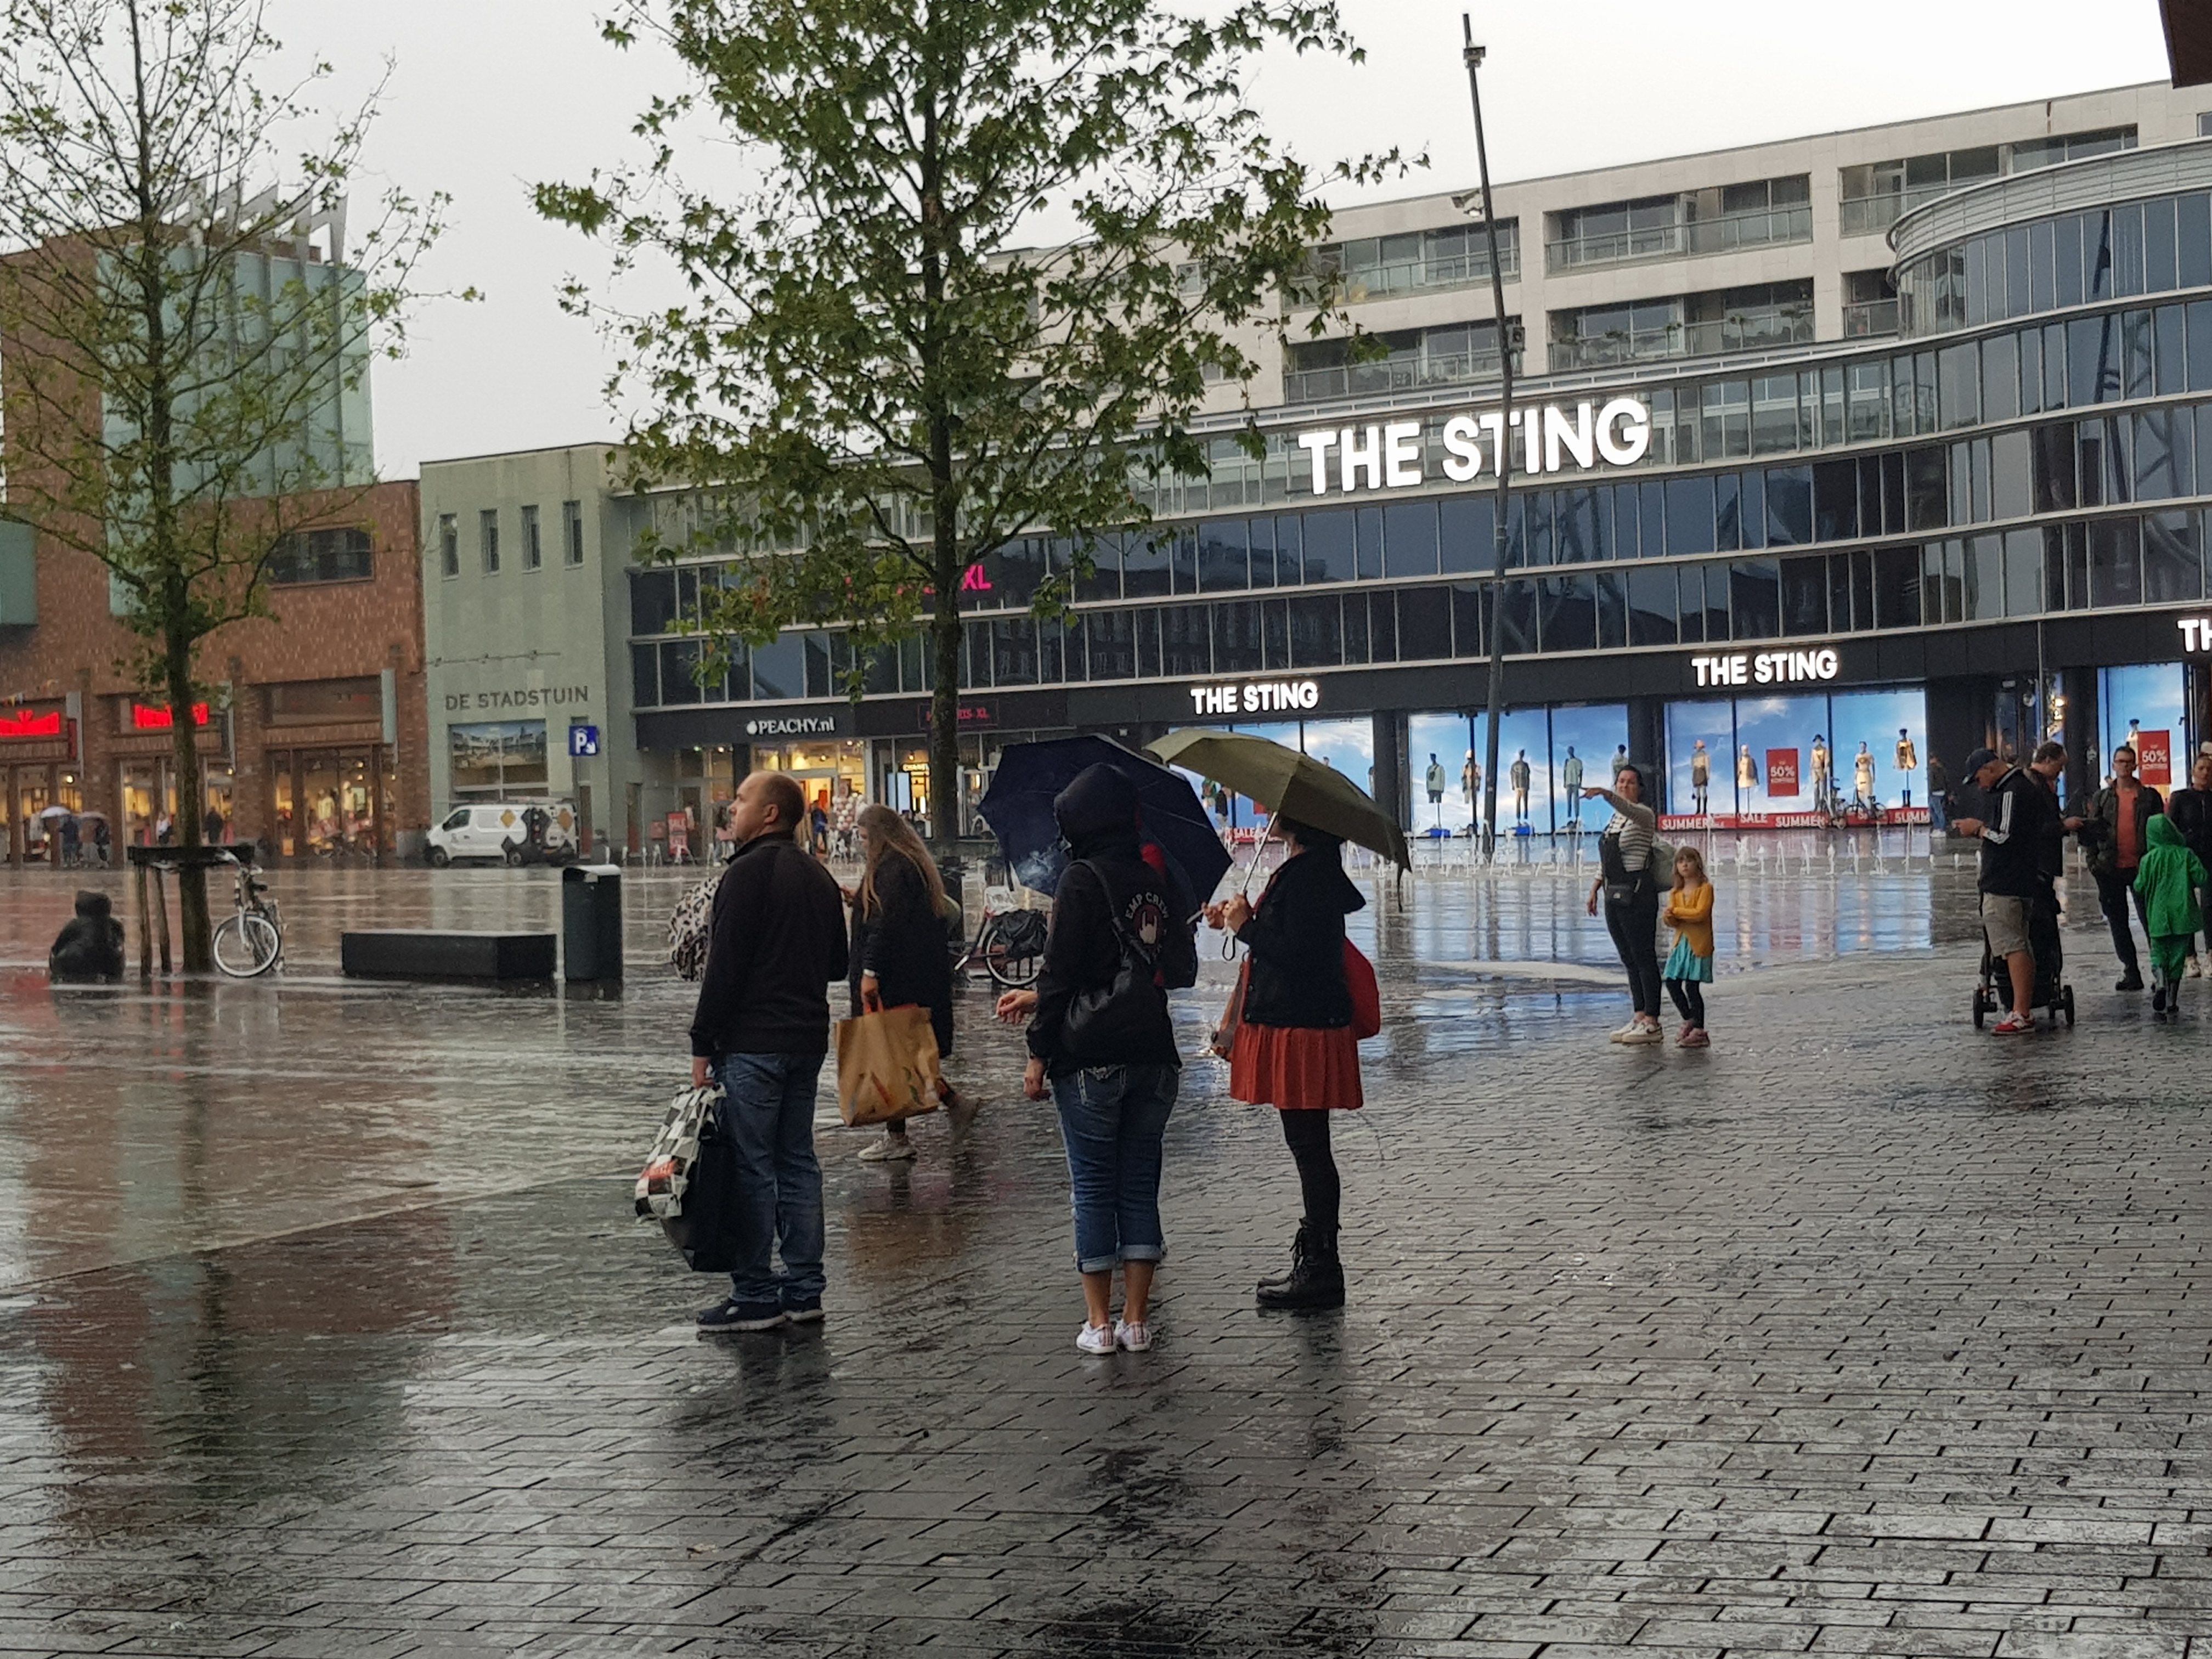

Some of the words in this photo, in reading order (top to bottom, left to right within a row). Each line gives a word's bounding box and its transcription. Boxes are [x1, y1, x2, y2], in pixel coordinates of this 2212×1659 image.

[1298, 422, 1423, 494] THE
[1442, 398, 1649, 482] STING
[962, 565, 992, 591] XL
[1691, 656, 1747, 686] THE
[1754, 650, 1838, 683] STING
[445, 693, 470, 710] DE
[478, 686, 588, 708] STADSTUIN
[1190, 686, 1238, 714] THE
[1243, 681, 1318, 712] STING
[758, 716, 835, 735] PEACHY.nl
[576, 733, 588, 754] P
[2141, 749, 2168, 763] 50%
[1770, 765, 1795, 777] 50%
[1740, 814, 1768, 823] SALE
[1125, 894, 1143, 919] EMP
